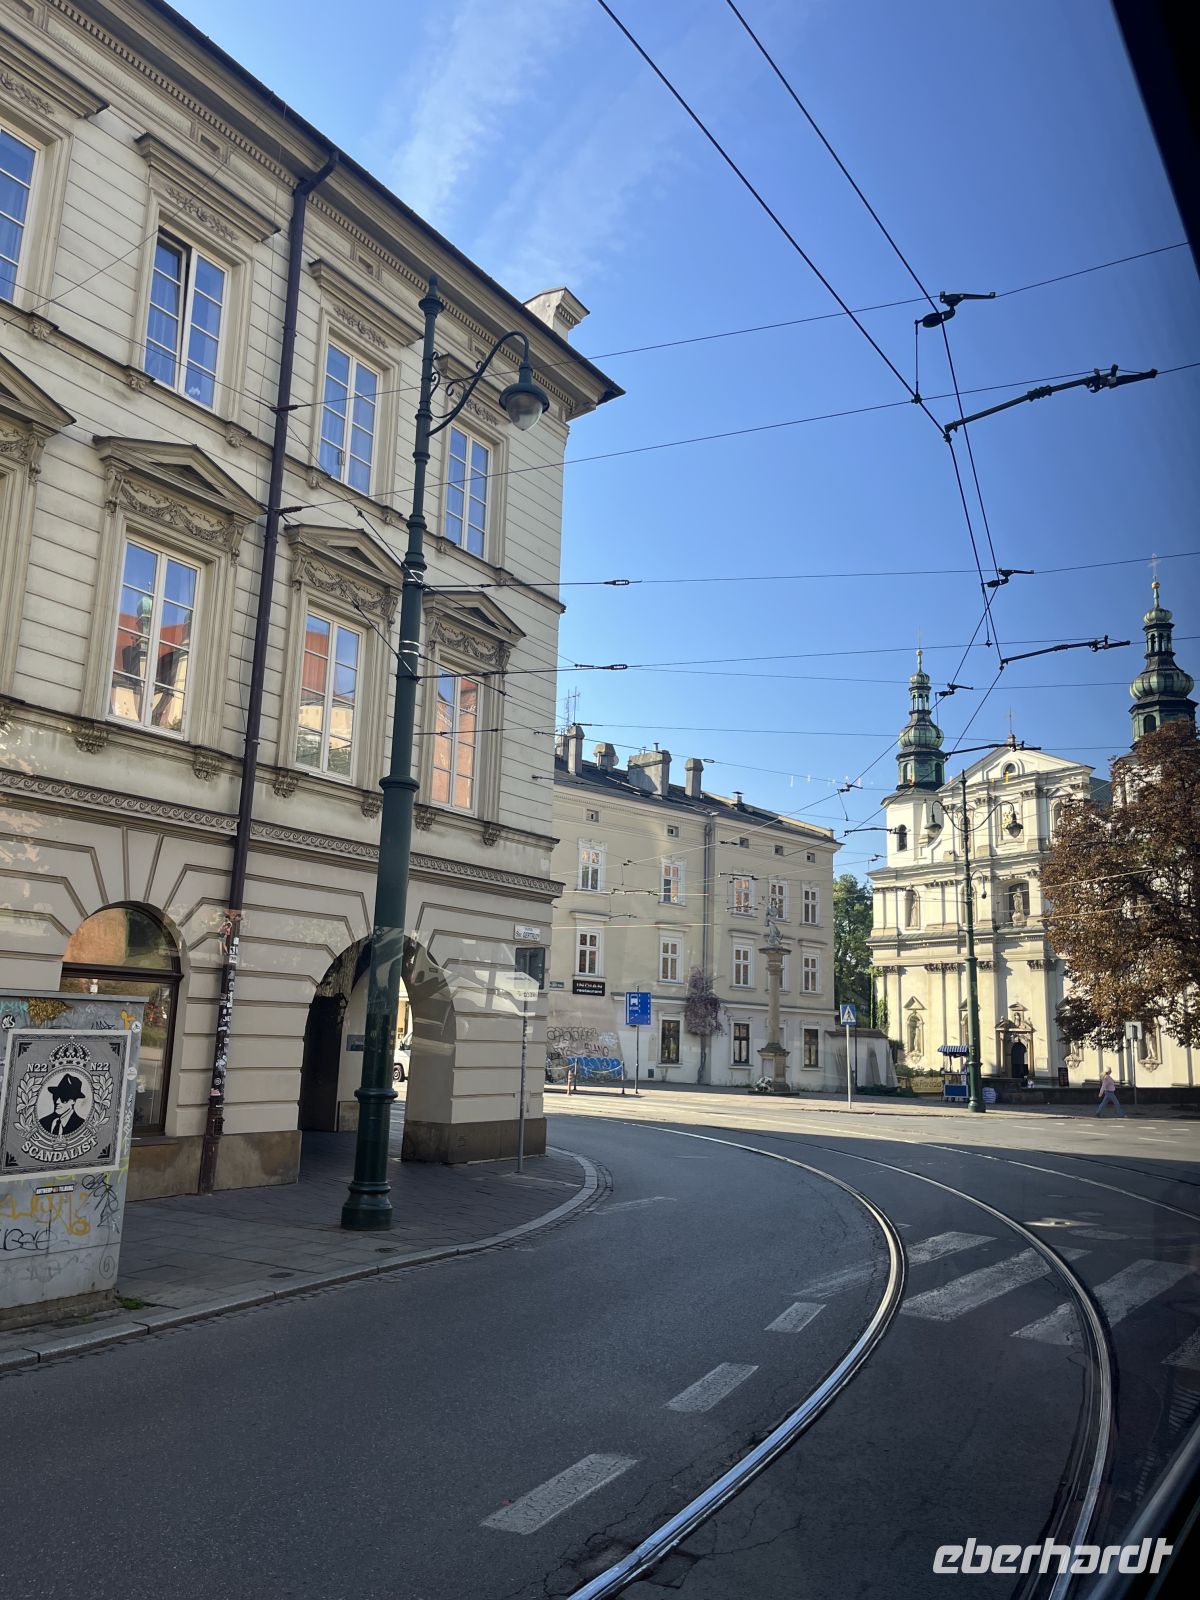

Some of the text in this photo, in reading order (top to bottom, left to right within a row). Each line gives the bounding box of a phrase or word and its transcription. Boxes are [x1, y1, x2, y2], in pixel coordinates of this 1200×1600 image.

[26, 1063, 48, 1073] N22
[90, 1062, 110, 1071] N22
[21, 1136, 99, 1162] SCANDALIST
